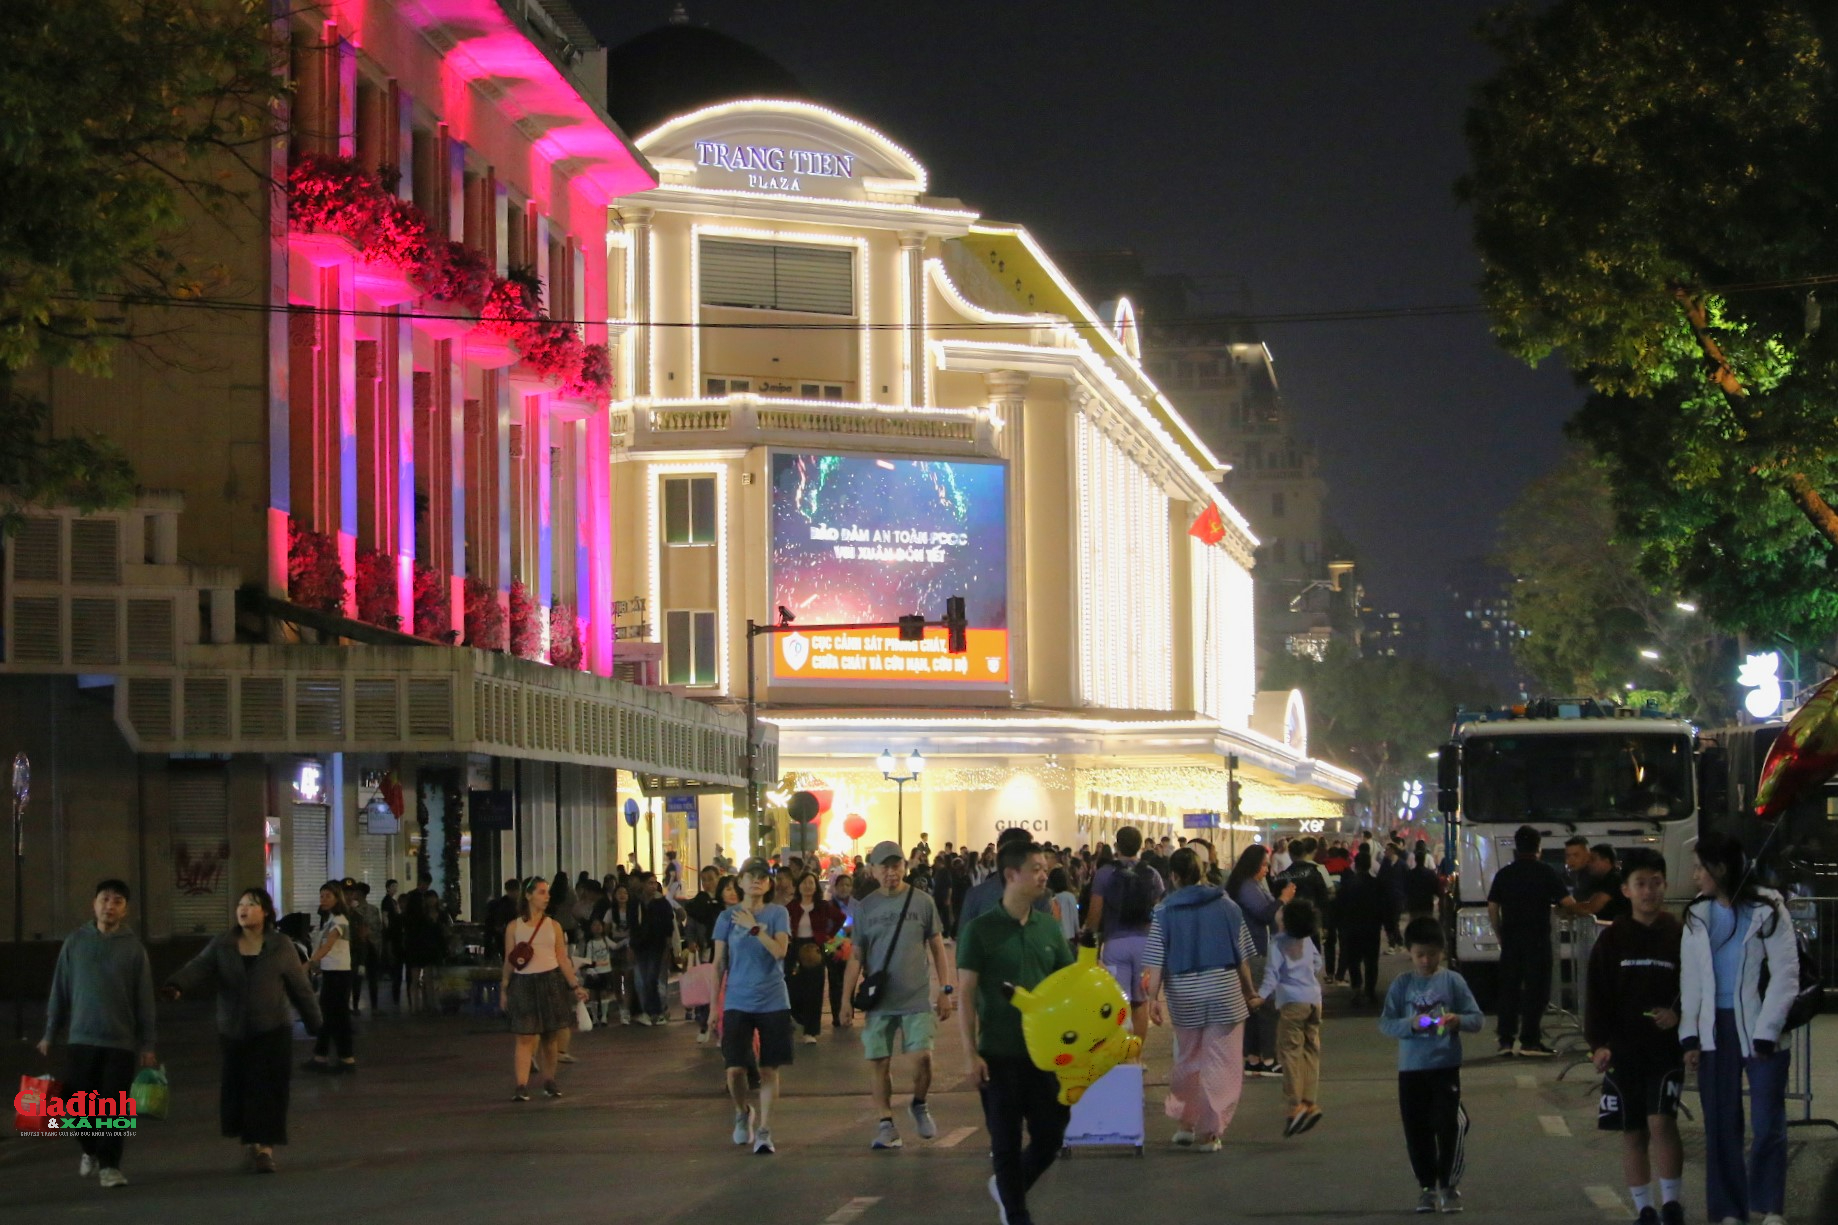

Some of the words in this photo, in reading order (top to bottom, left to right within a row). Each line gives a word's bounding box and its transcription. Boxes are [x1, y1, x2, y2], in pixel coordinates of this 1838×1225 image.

[694, 142, 786, 173] TRANG
[790, 151, 854, 178] TIEN
[748, 174, 801, 192] PLAZA
[873, 529, 891, 544] AN
[894, 528, 928, 545] TOÀN
[811, 635, 832, 651] CỤC
[834, 632, 862, 651] CẢNH
[864, 635, 882, 651] SÁT
[841, 655, 866, 670] CHÁY
[868, 654, 882, 671] VÀ
[995, 820, 1048, 832] GUCCI
